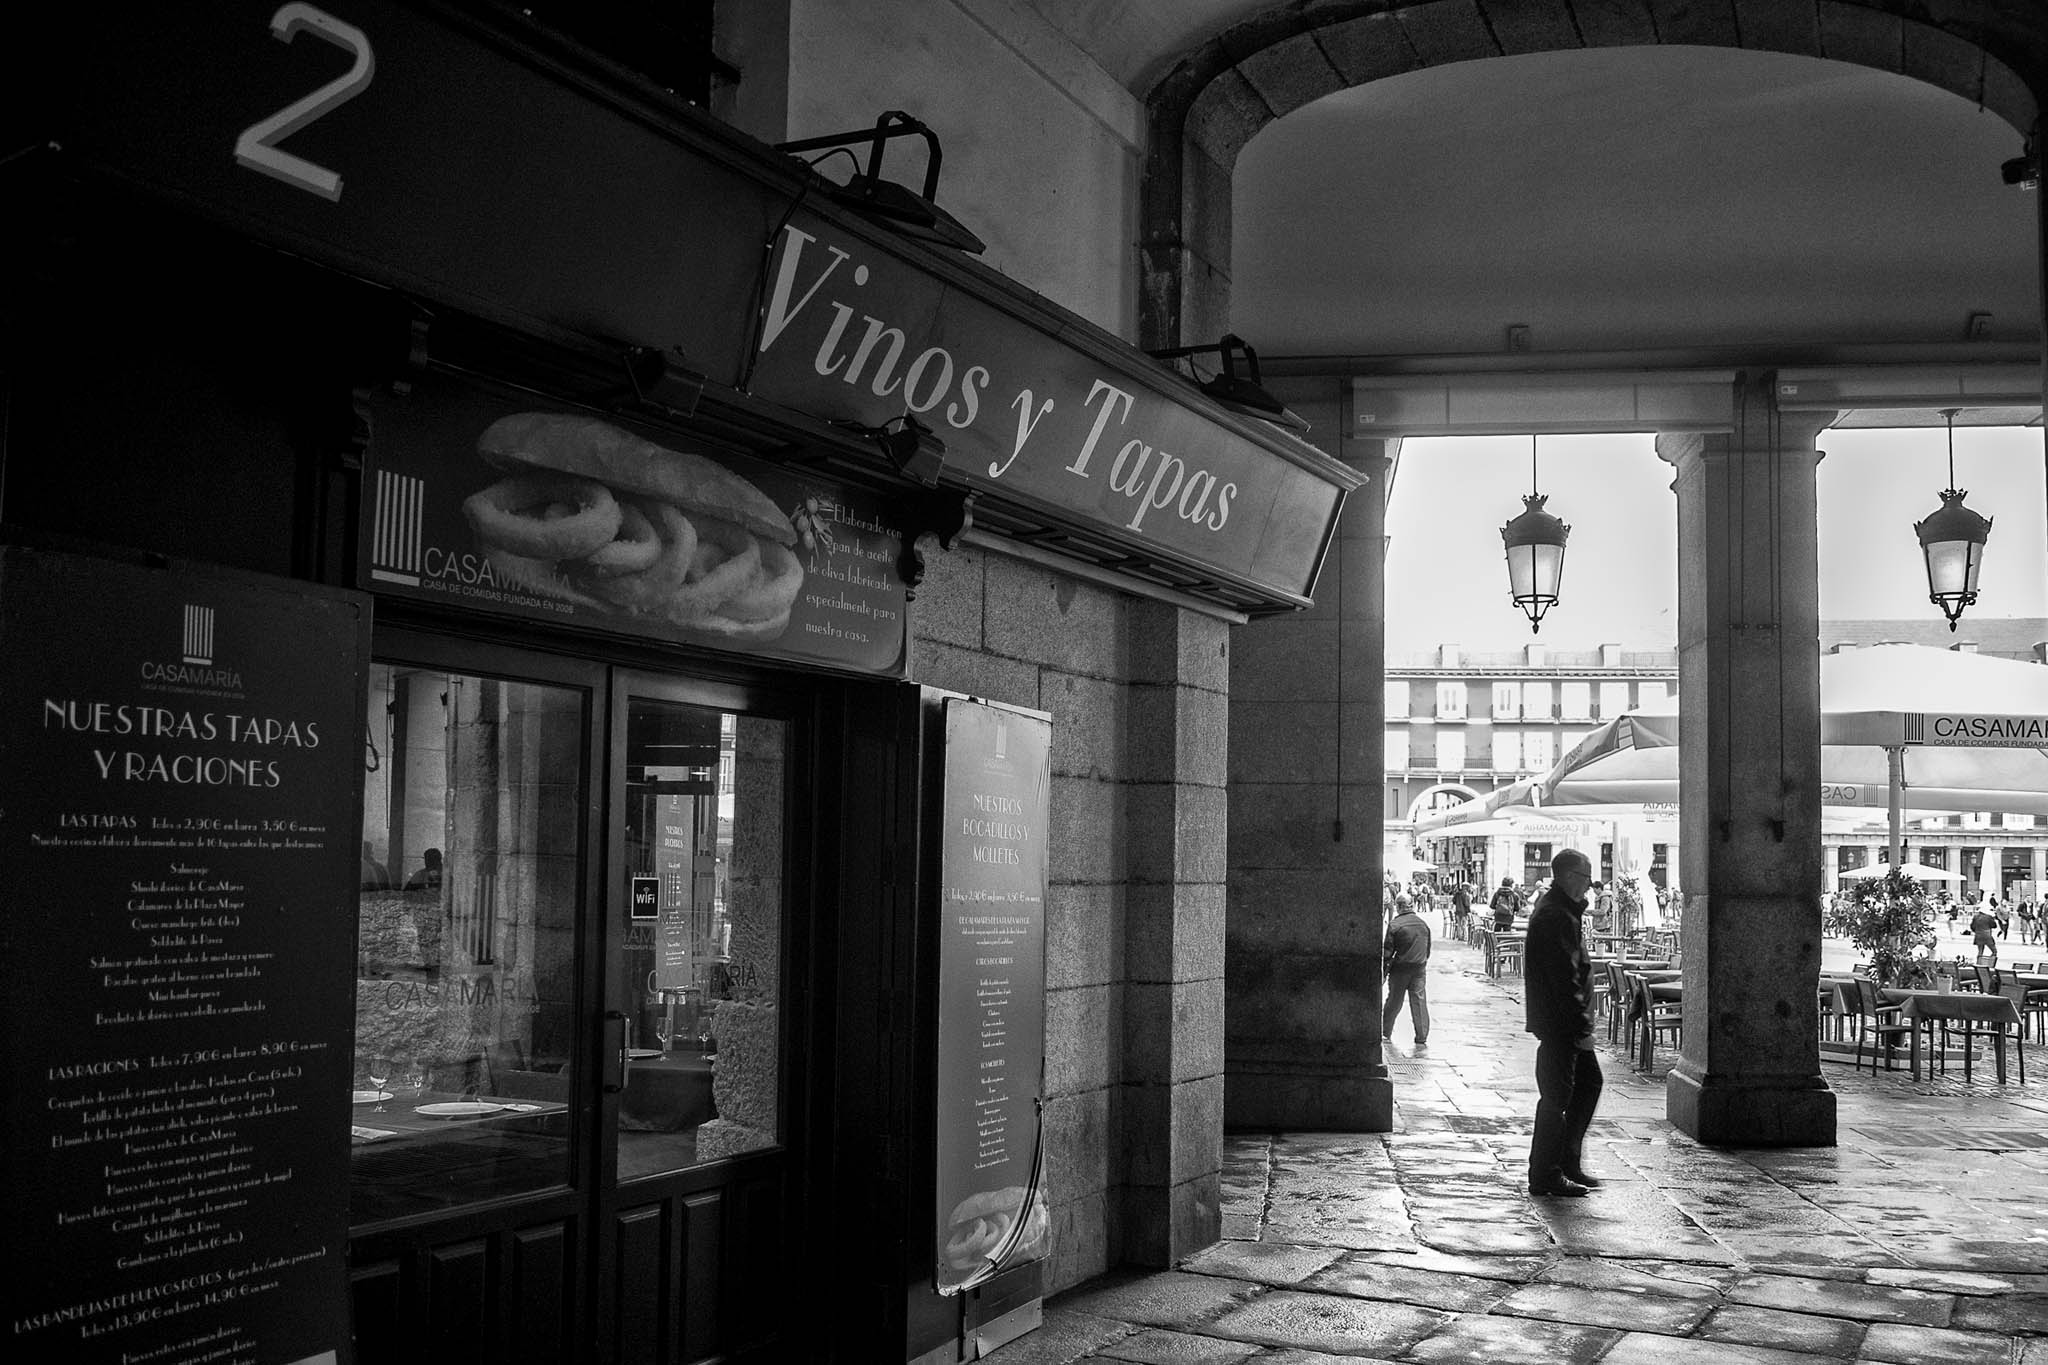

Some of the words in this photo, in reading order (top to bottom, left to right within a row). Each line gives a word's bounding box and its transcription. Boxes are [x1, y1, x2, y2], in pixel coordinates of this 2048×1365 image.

[233, 2, 376, 203] 2
[758, 225, 989, 430] Vinos
[989, 388, 1053, 479] y
[1065, 377, 1238, 533] Tapas
[833, 503, 885, 534] Elaborado
[886, 526, 903, 539] con
[833, 541, 850, 555] pan
[853, 538, 864, 557] de
[866, 548, 894, 563] aceite
[807, 556, 819, 574] de
[821, 560, 844, 581] oliva
[847, 565, 892, 592] fabricado
[422, 578, 447, 591] CASA
[448, 583, 461, 594] DE
[463, 586, 502, 601] COMIDAS
[503, 593, 542, 609] FUNDADA
[543, 600, 554, 610] EN
[806, 592, 871, 616] especialmente
[873, 607, 896, 620] para
[806, 621, 842, 638] nuestra
[844, 629, 869, 643] casa.
[44, 698, 217, 740] NUESTRAS
[226, 714, 320, 748] TAPAS
[94, 749, 116, 780] Y
[125, 752, 281, 788] RACIONES
[973, 793, 1023, 815] NUESTROS
[61, 814, 88, 826] LAS
[92, 815, 137, 827] TAPAS
[963, 818, 1023, 841] BOCADILLOS
[973, 846, 1020, 864] MOLLETES
[49, 1067, 74, 1080] LAS
[76, 1060, 139, 1076] RACIONES
[15, 1318, 40, 1333] LAS
[42, 1300, 111, 1326] BANDEJAS
[112, 1295, 126, 1308] DE
[130, 1283, 180, 1303] HUEVOS
[181, 1273, 222, 1290] ROTOS
